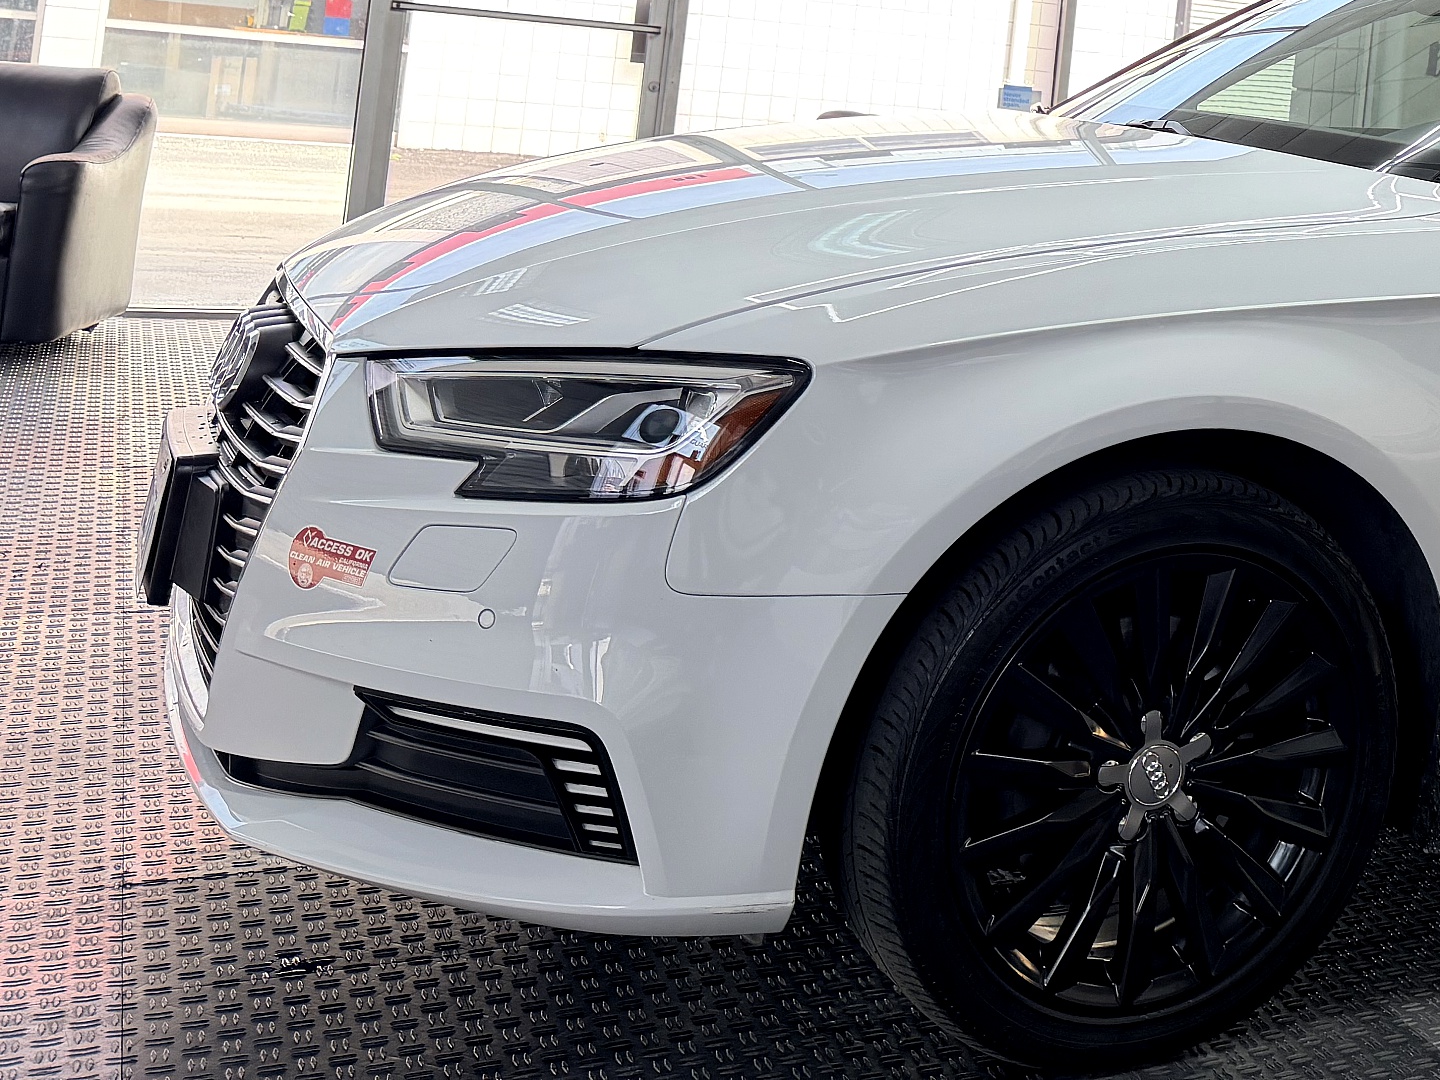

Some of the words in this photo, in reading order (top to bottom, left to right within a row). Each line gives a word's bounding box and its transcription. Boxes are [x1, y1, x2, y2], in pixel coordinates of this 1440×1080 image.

[310, 537, 354, 557] ACCESS
[354, 549, 374, 562] OK
[289, 550, 316, 564] CLEAN
[315, 558, 331, 569] AIR
[332, 563, 367, 578] VEHICLE
